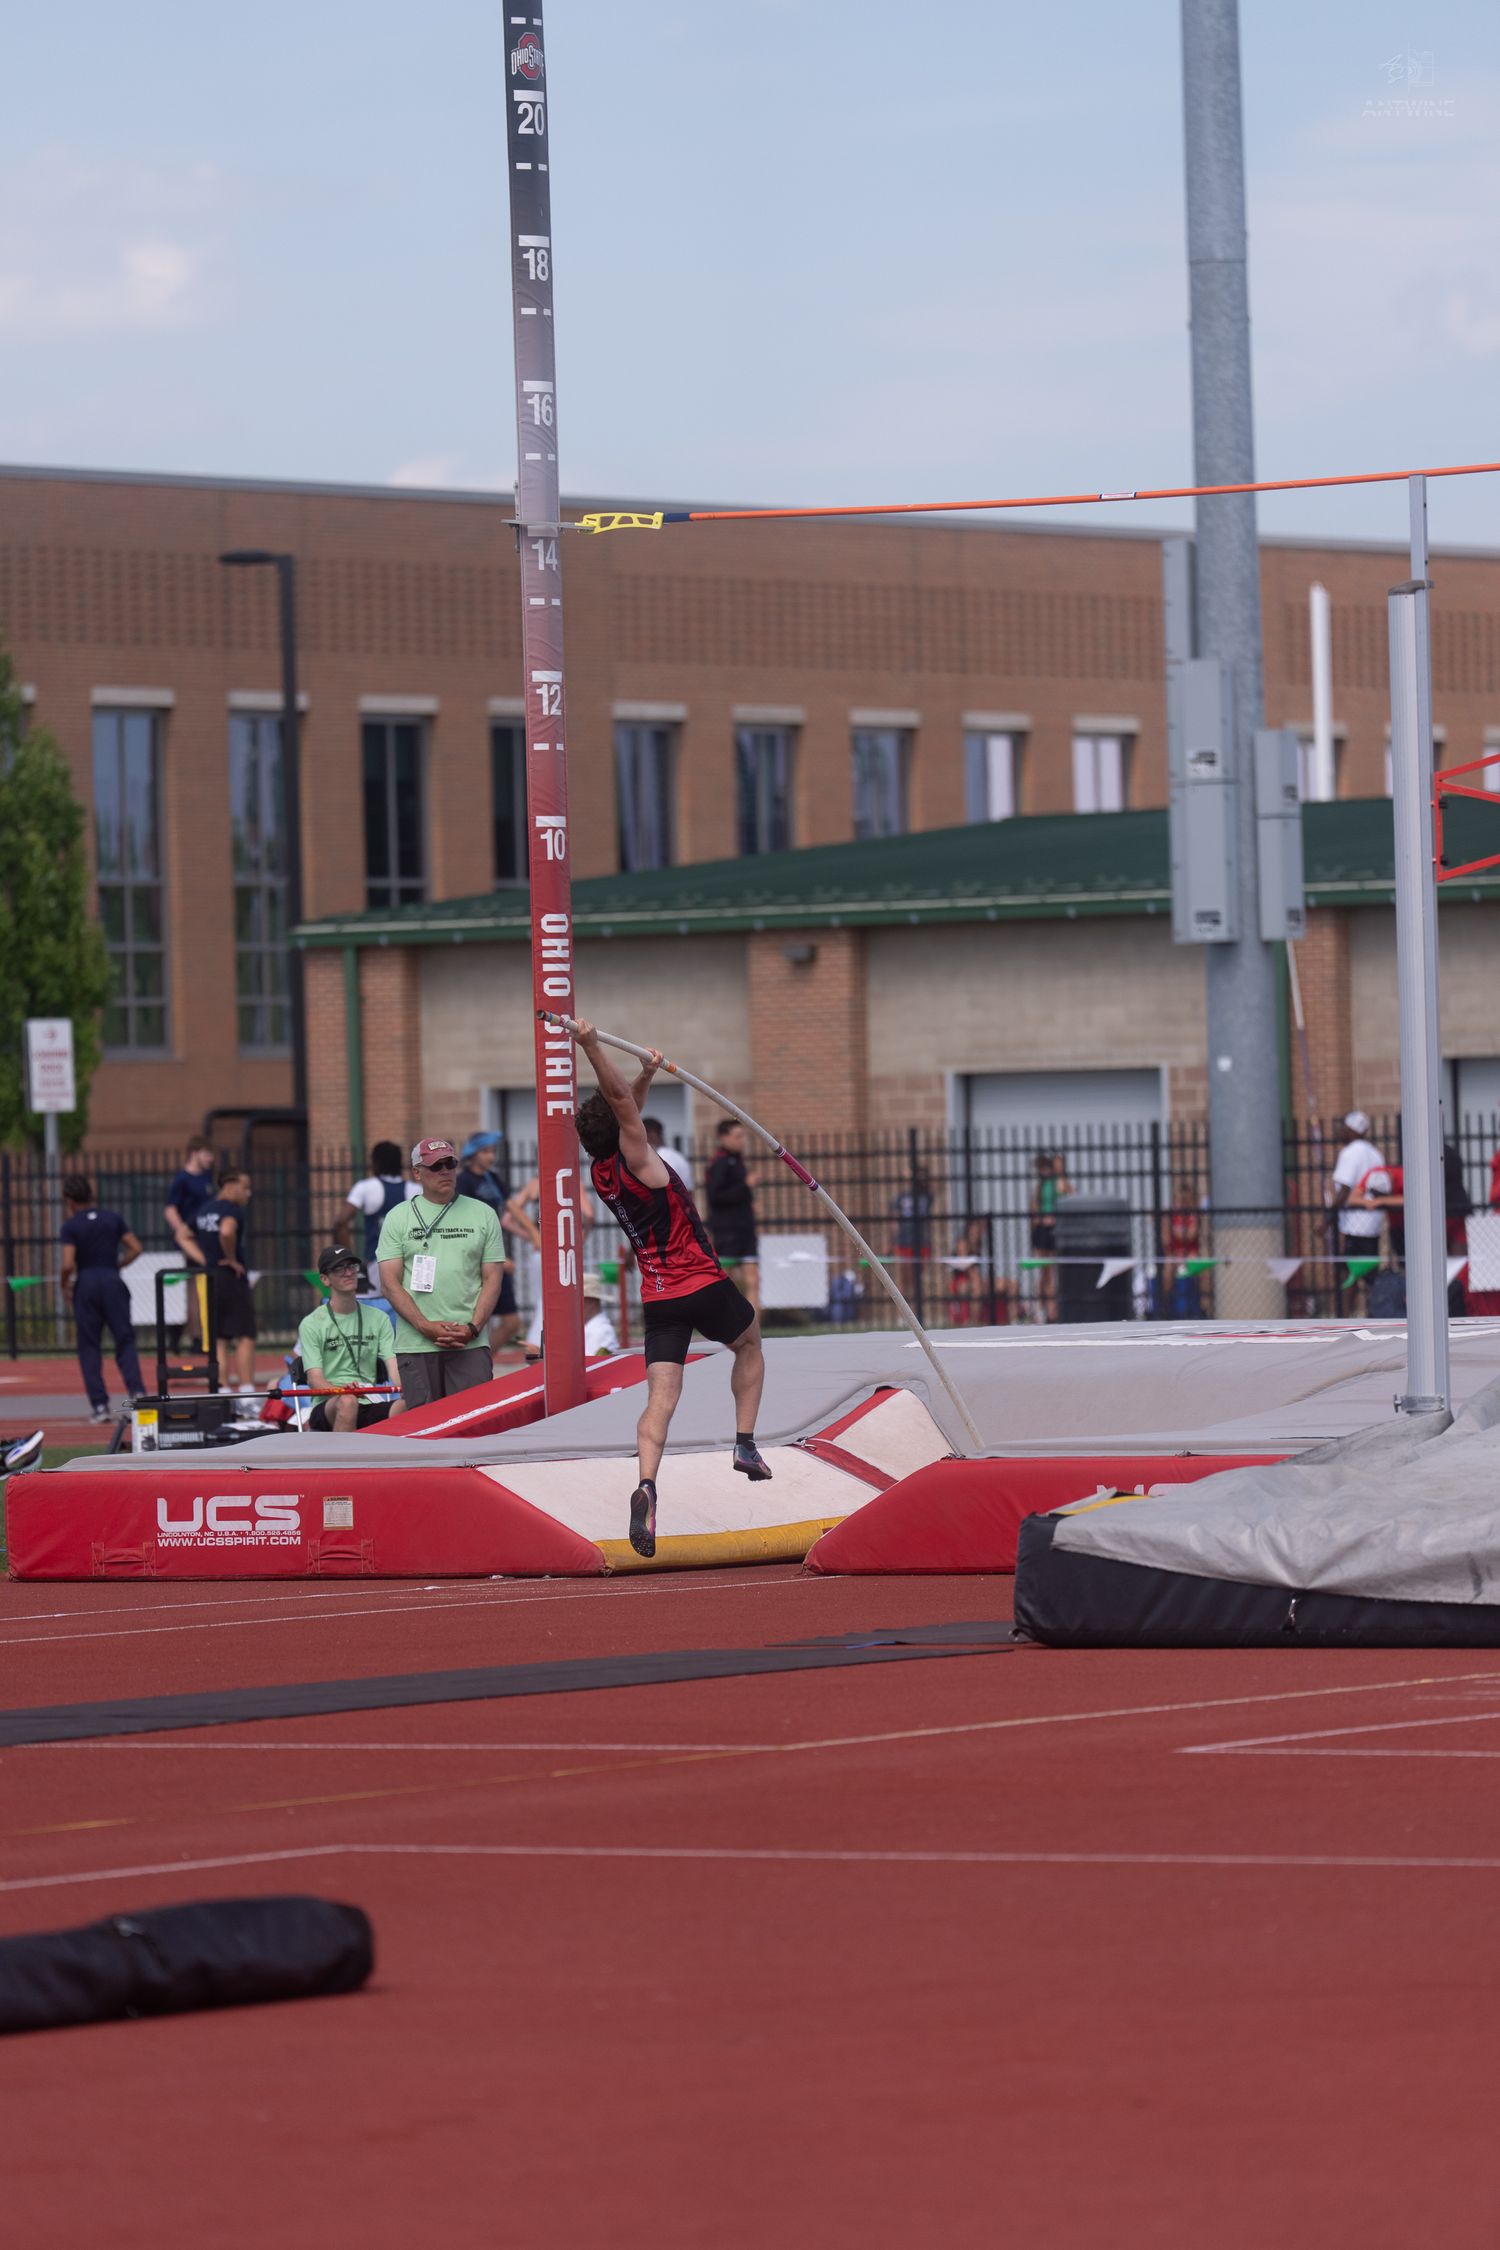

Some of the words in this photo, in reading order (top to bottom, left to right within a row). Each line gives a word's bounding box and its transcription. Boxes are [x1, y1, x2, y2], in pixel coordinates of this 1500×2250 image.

[511, 48, 529, 75] OHIO
[517, 103, 545, 135] 20
[523, 248, 549, 282] 18
[527, 393, 553, 427] 16
[531, 539, 558, 572] 14
[535, 683, 562, 716] 12
[540, 827, 566, 861] 10
[540, 913, 571, 997] OHIO
[544, 1013, 575, 1117] STATE
[556, 1168, 577, 1288] UCS
[157, 1494, 301, 1532] UCS
[157, 1536, 301, 1547] WWW.UCSSPIRIT.COM
